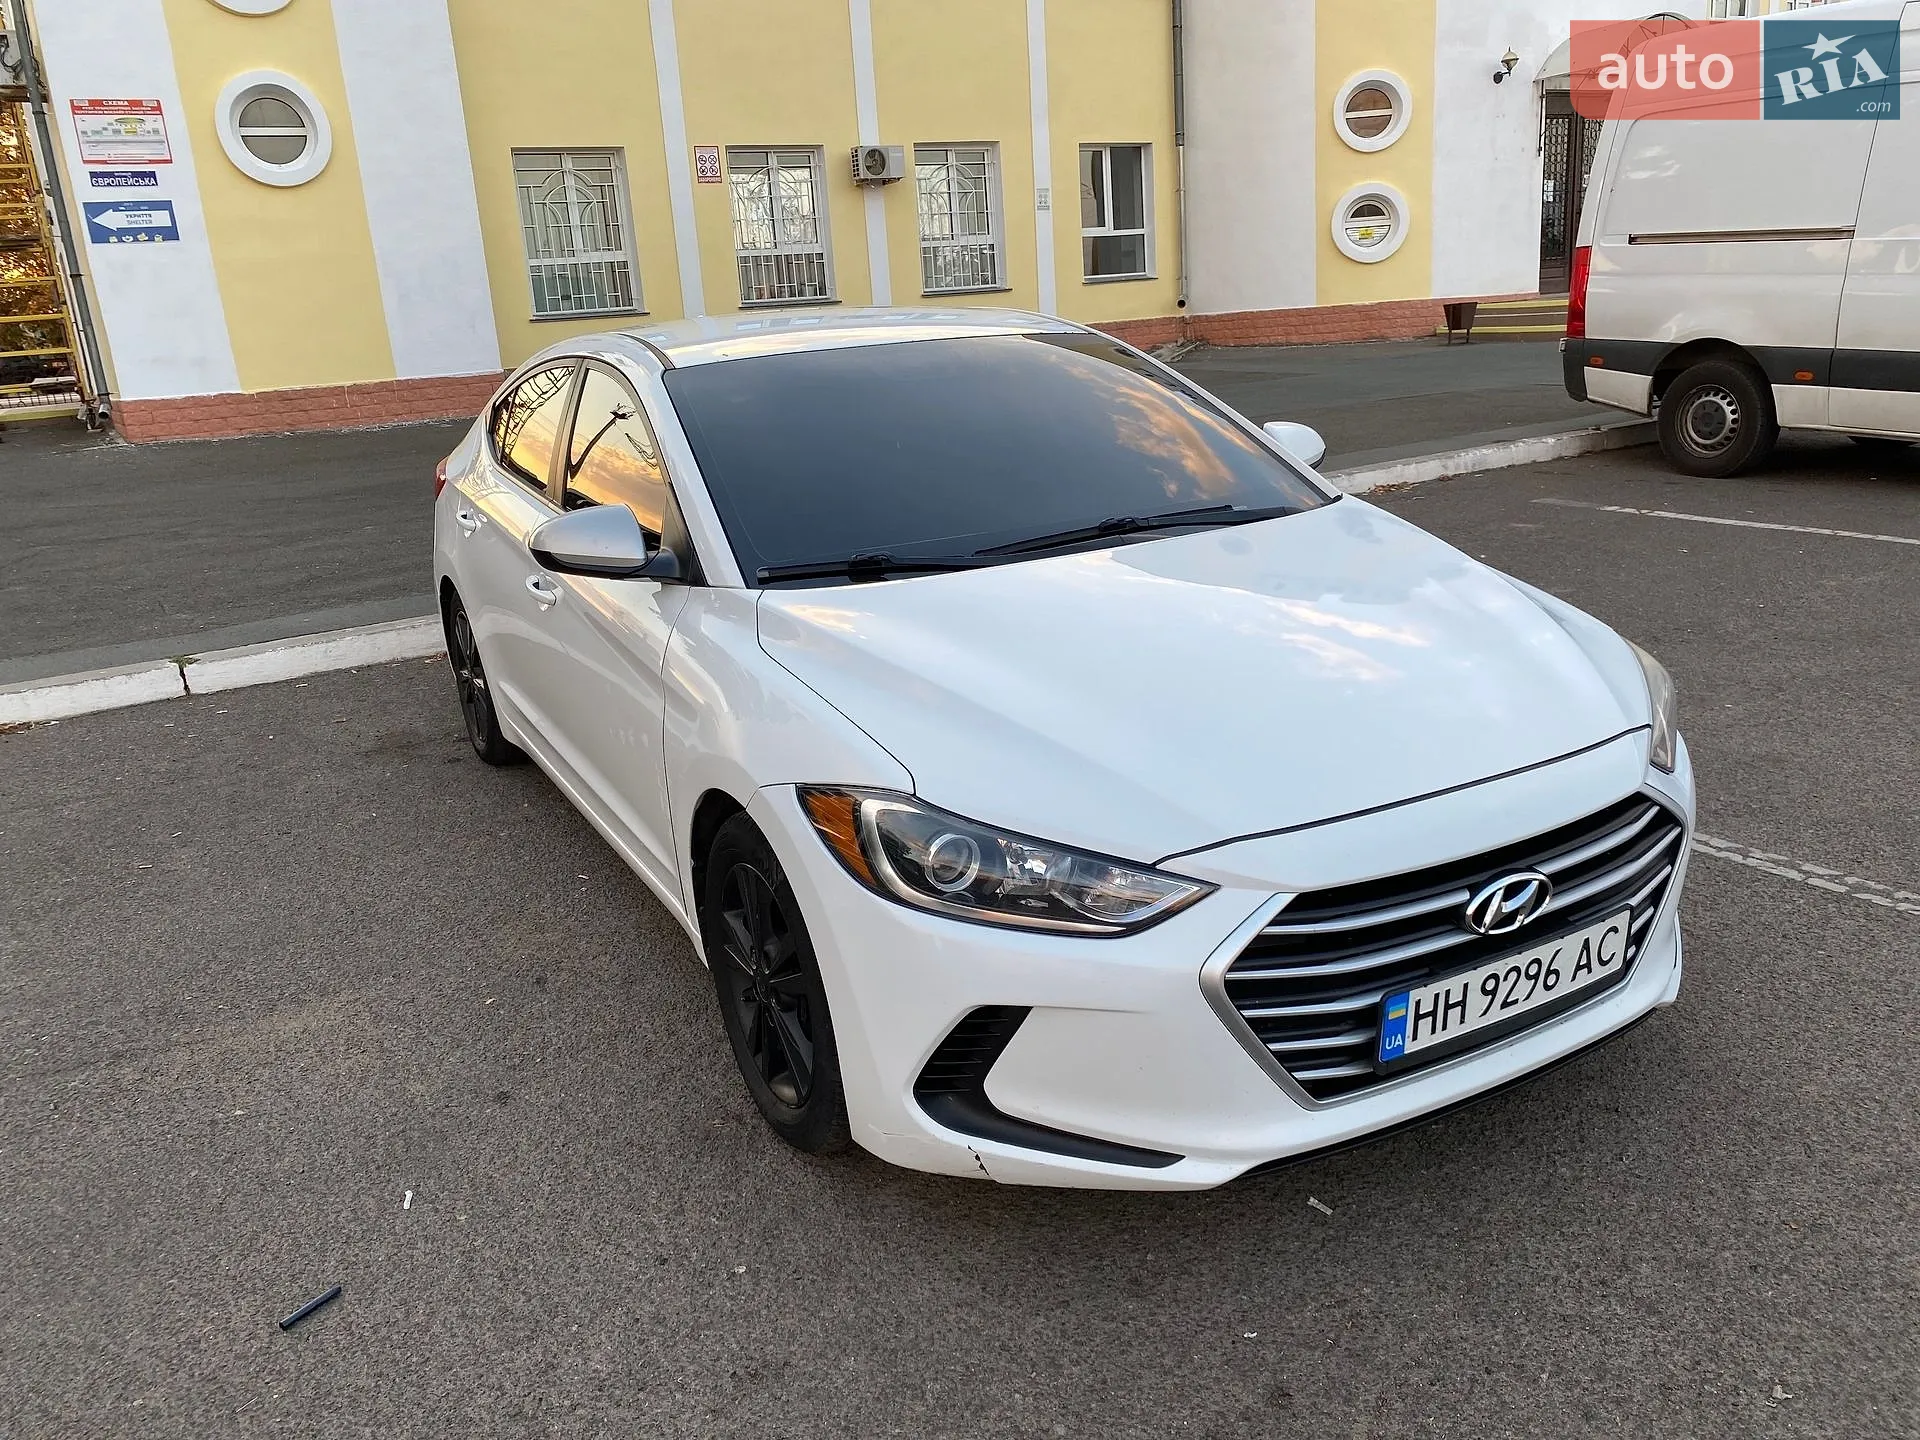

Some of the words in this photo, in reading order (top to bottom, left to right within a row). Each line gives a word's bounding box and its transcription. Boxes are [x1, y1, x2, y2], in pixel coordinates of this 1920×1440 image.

[92, 176, 156, 186] ЄВРОПЕЙСЬКА
[1411, 981, 1470, 1042] HH
[1478, 947, 1563, 1018] 9296
[1570, 925, 1619, 983] AC
[1385, 1033, 1403, 1050] UA
